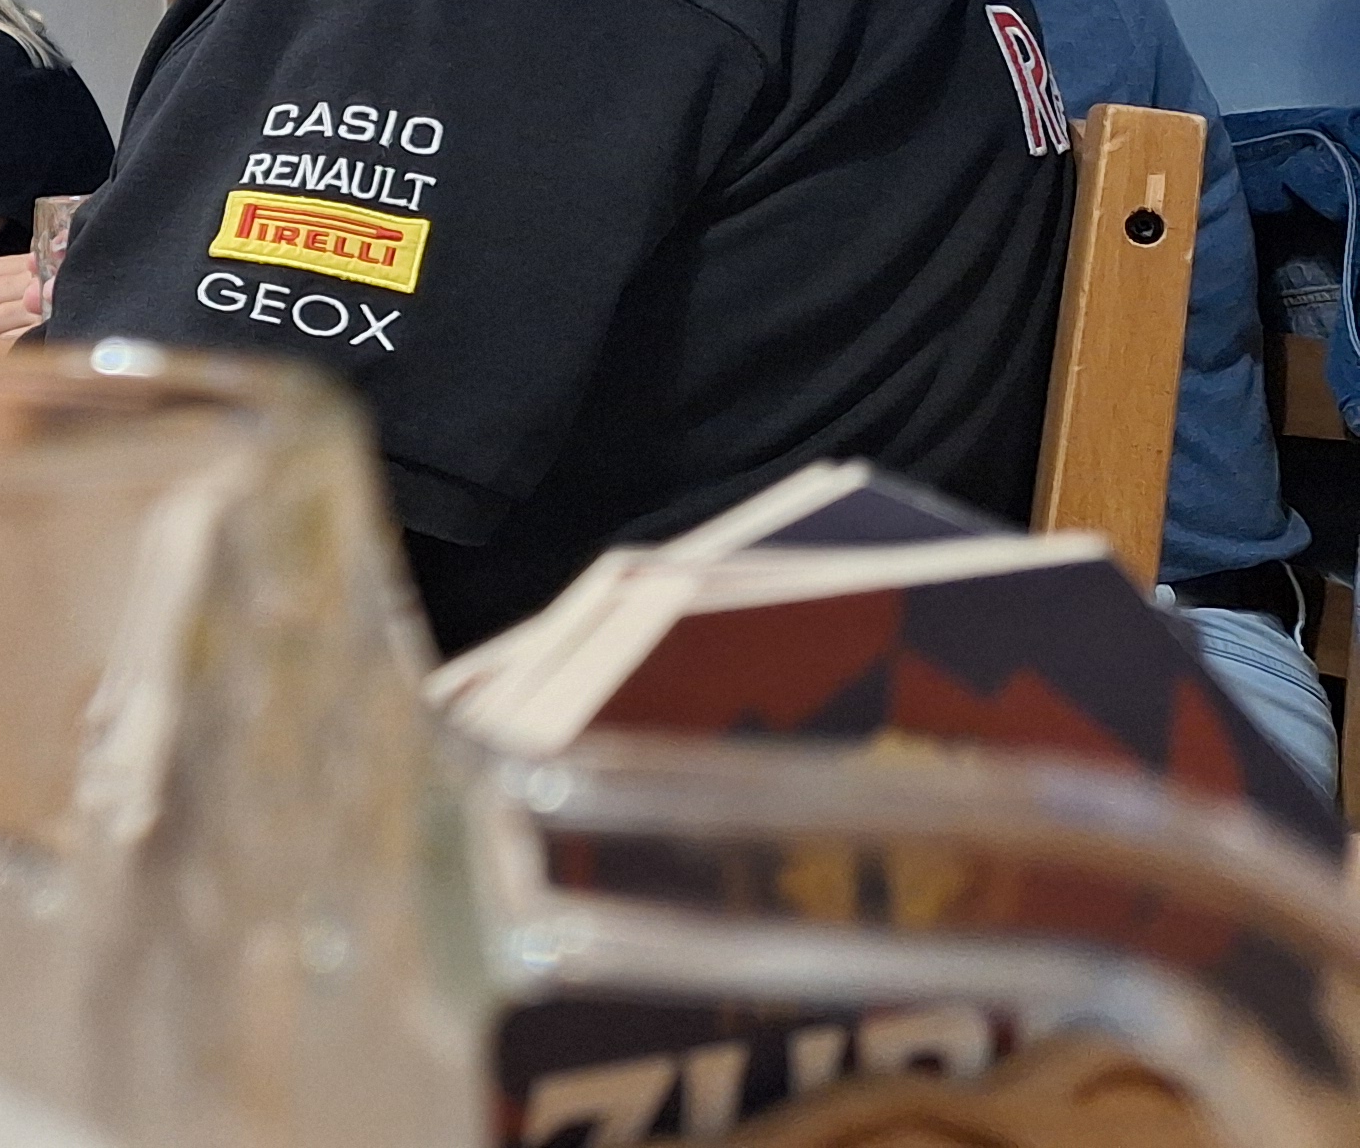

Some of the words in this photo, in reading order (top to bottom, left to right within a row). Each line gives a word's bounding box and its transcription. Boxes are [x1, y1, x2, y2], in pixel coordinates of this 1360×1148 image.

[262, 101, 444, 155] CASIO
[238, 153, 437, 211] RENAULT
[234, 202, 404, 267] PIRELLI
[197, 272, 401, 351] GEOX
